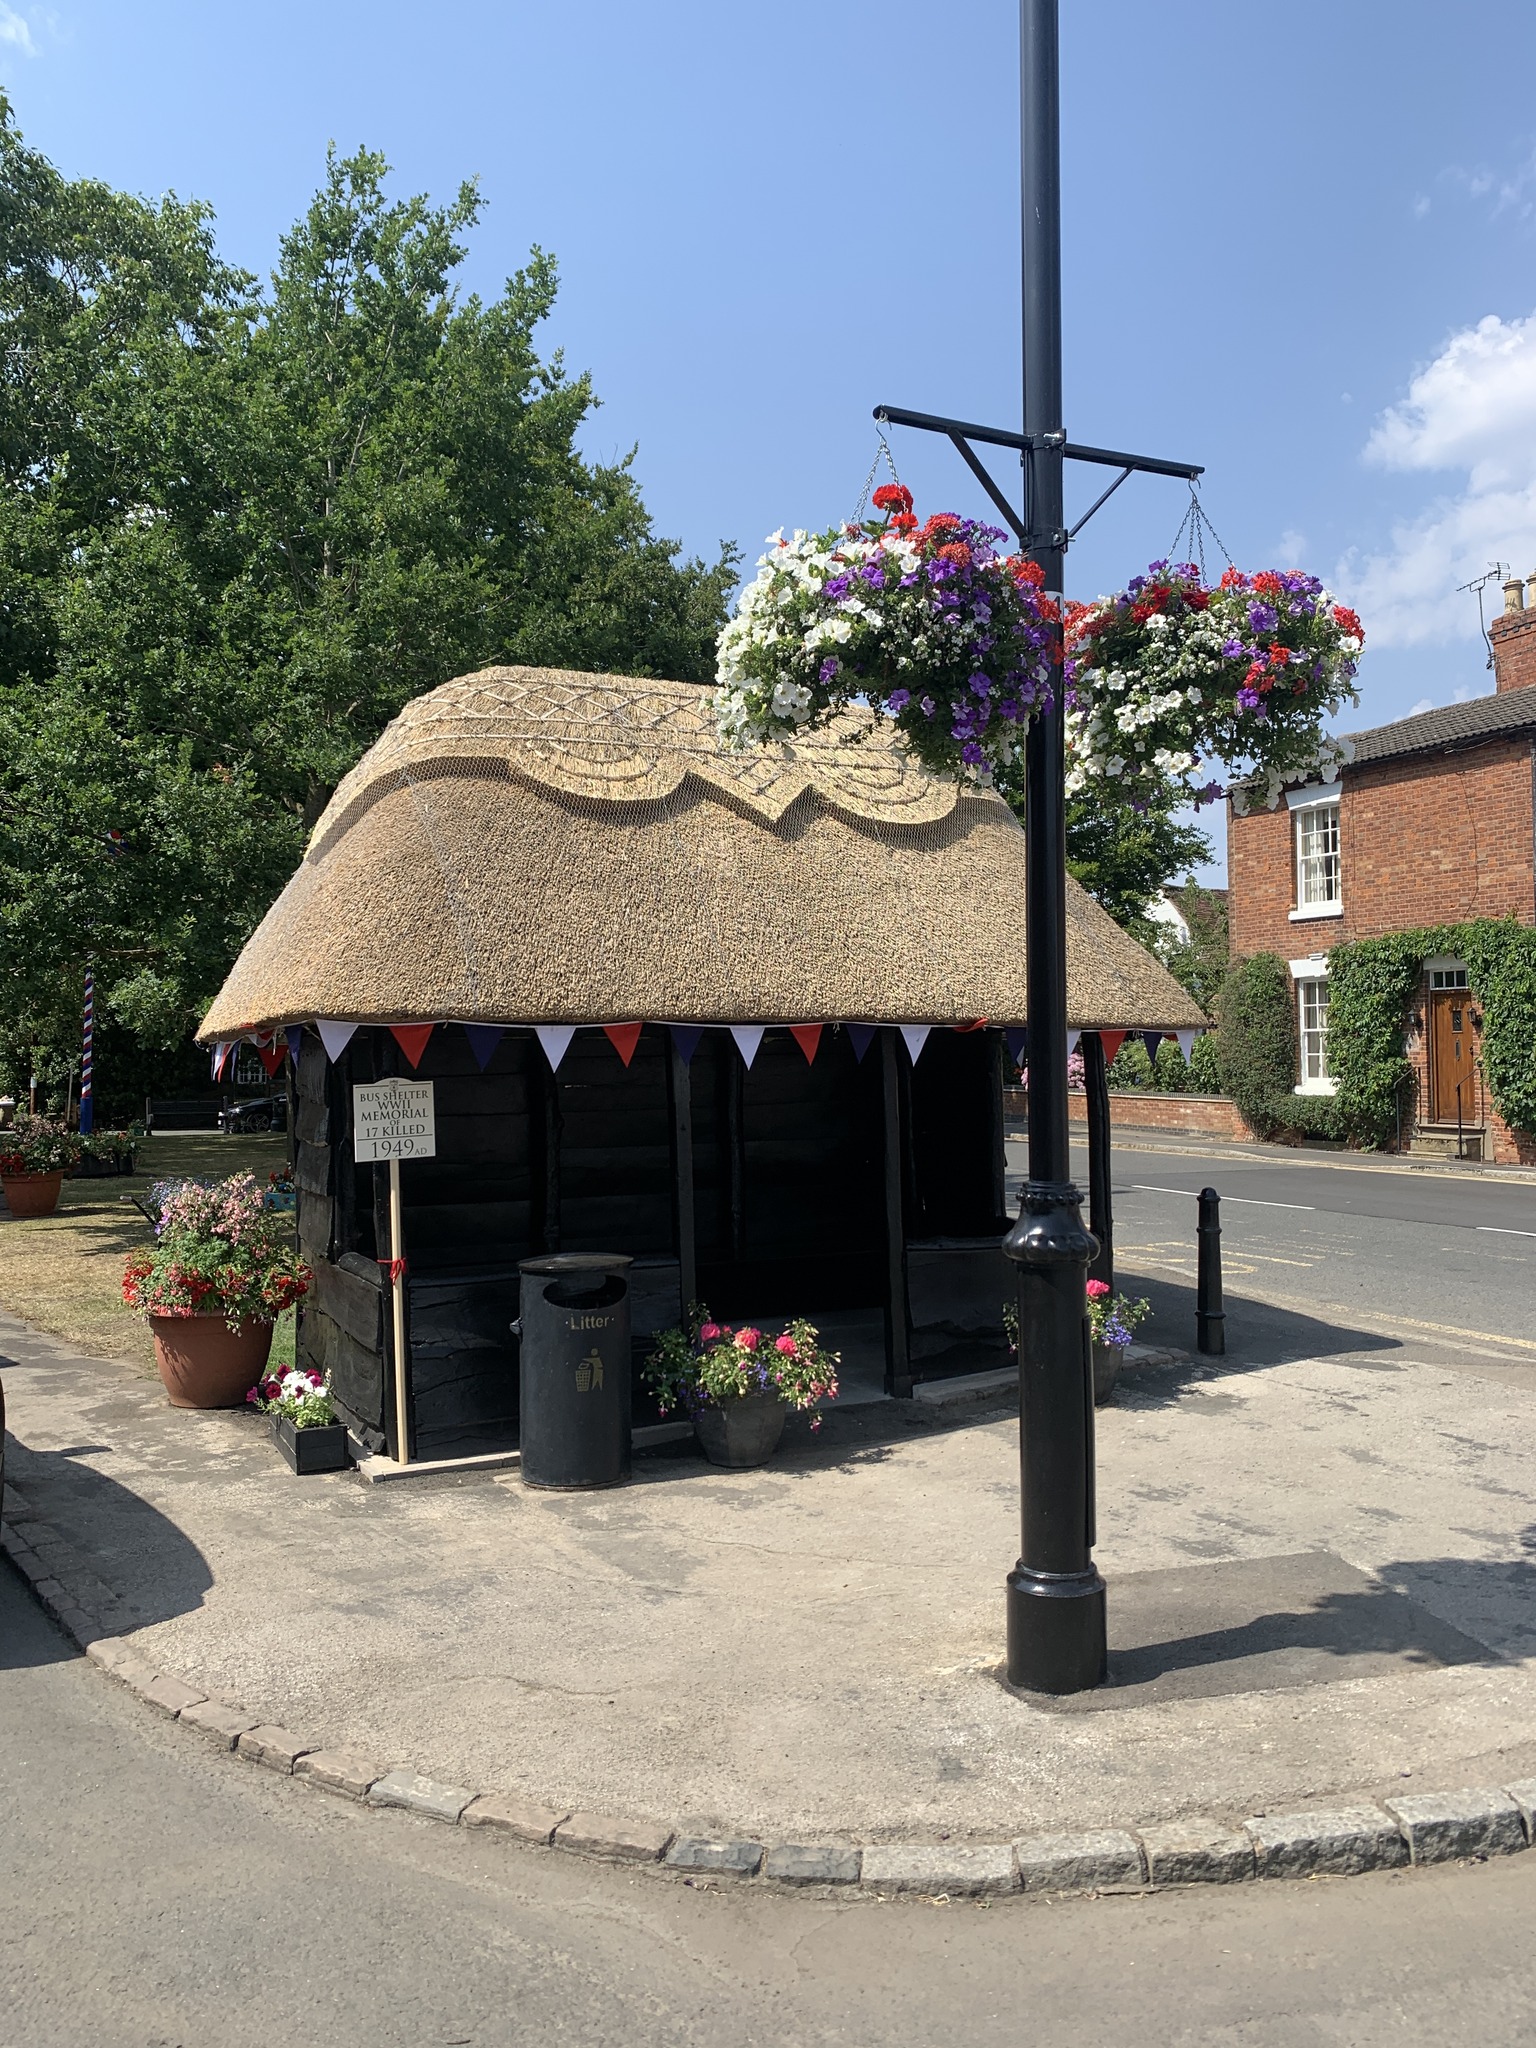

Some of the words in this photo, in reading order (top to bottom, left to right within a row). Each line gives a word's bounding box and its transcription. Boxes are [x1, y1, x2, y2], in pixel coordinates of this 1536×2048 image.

[360, 1092, 380, 1102] BUS
[383, 1090, 429, 1100] SHELTER
[377, 1099, 411, 1110] WWII
[361, 1108, 429, 1121] MEMORIAL
[366, 1127, 378, 1137] 17
[382, 1124, 425, 1136] KILLED
[371, 1138, 414, 1159] 1949
[414, 1147, 428, 1156] AD
[570, 1315, 610, 1330] Litter
